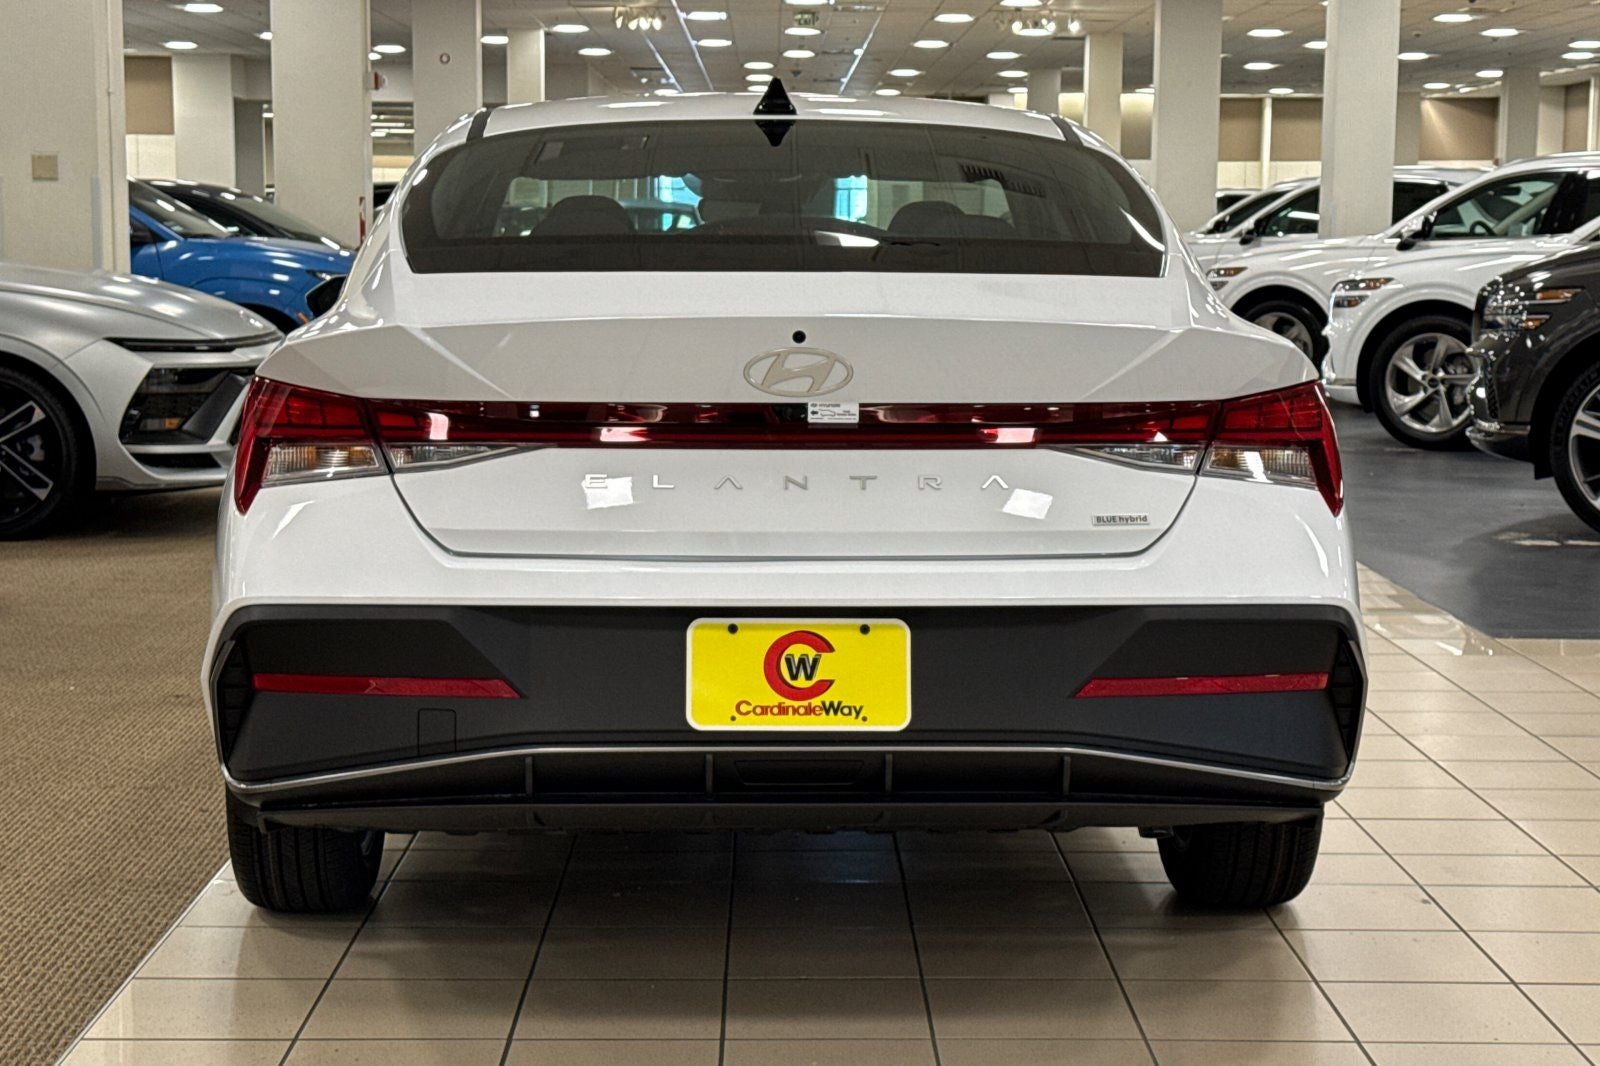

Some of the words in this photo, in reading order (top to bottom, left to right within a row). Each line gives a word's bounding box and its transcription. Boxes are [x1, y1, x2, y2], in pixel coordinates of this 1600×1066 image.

[584, 474, 1009, 490] ELANTRA
[1118, 515, 1148, 524] hybrid
[735, 700, 863, 719] CardinaleWay
